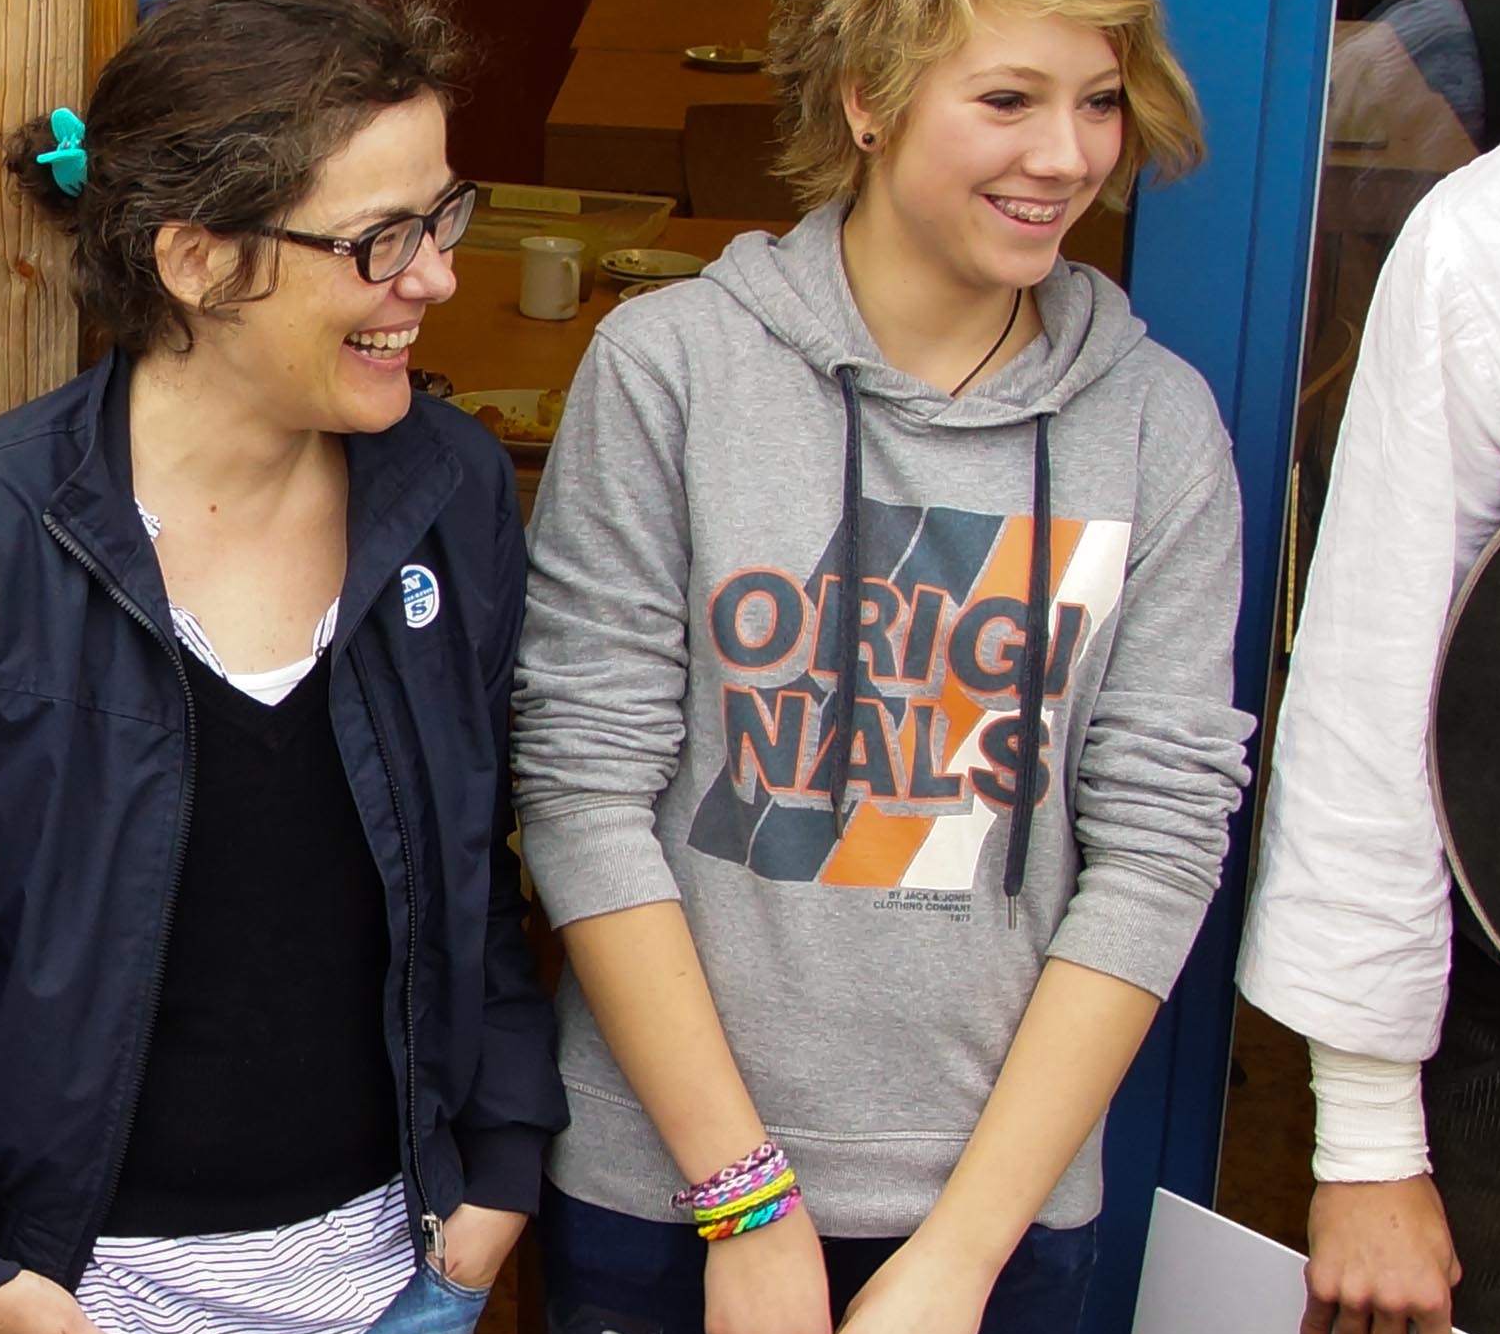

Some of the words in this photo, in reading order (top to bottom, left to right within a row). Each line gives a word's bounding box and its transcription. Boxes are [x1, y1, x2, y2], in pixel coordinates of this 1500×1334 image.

[706, 567, 1090, 700] ORIGI
[723, 683, 1052, 809] NALS
[873, 900, 923, 911] CLOTHING
[925, 902, 971, 913] COMPANY
[904, 891, 929, 901] JACK
